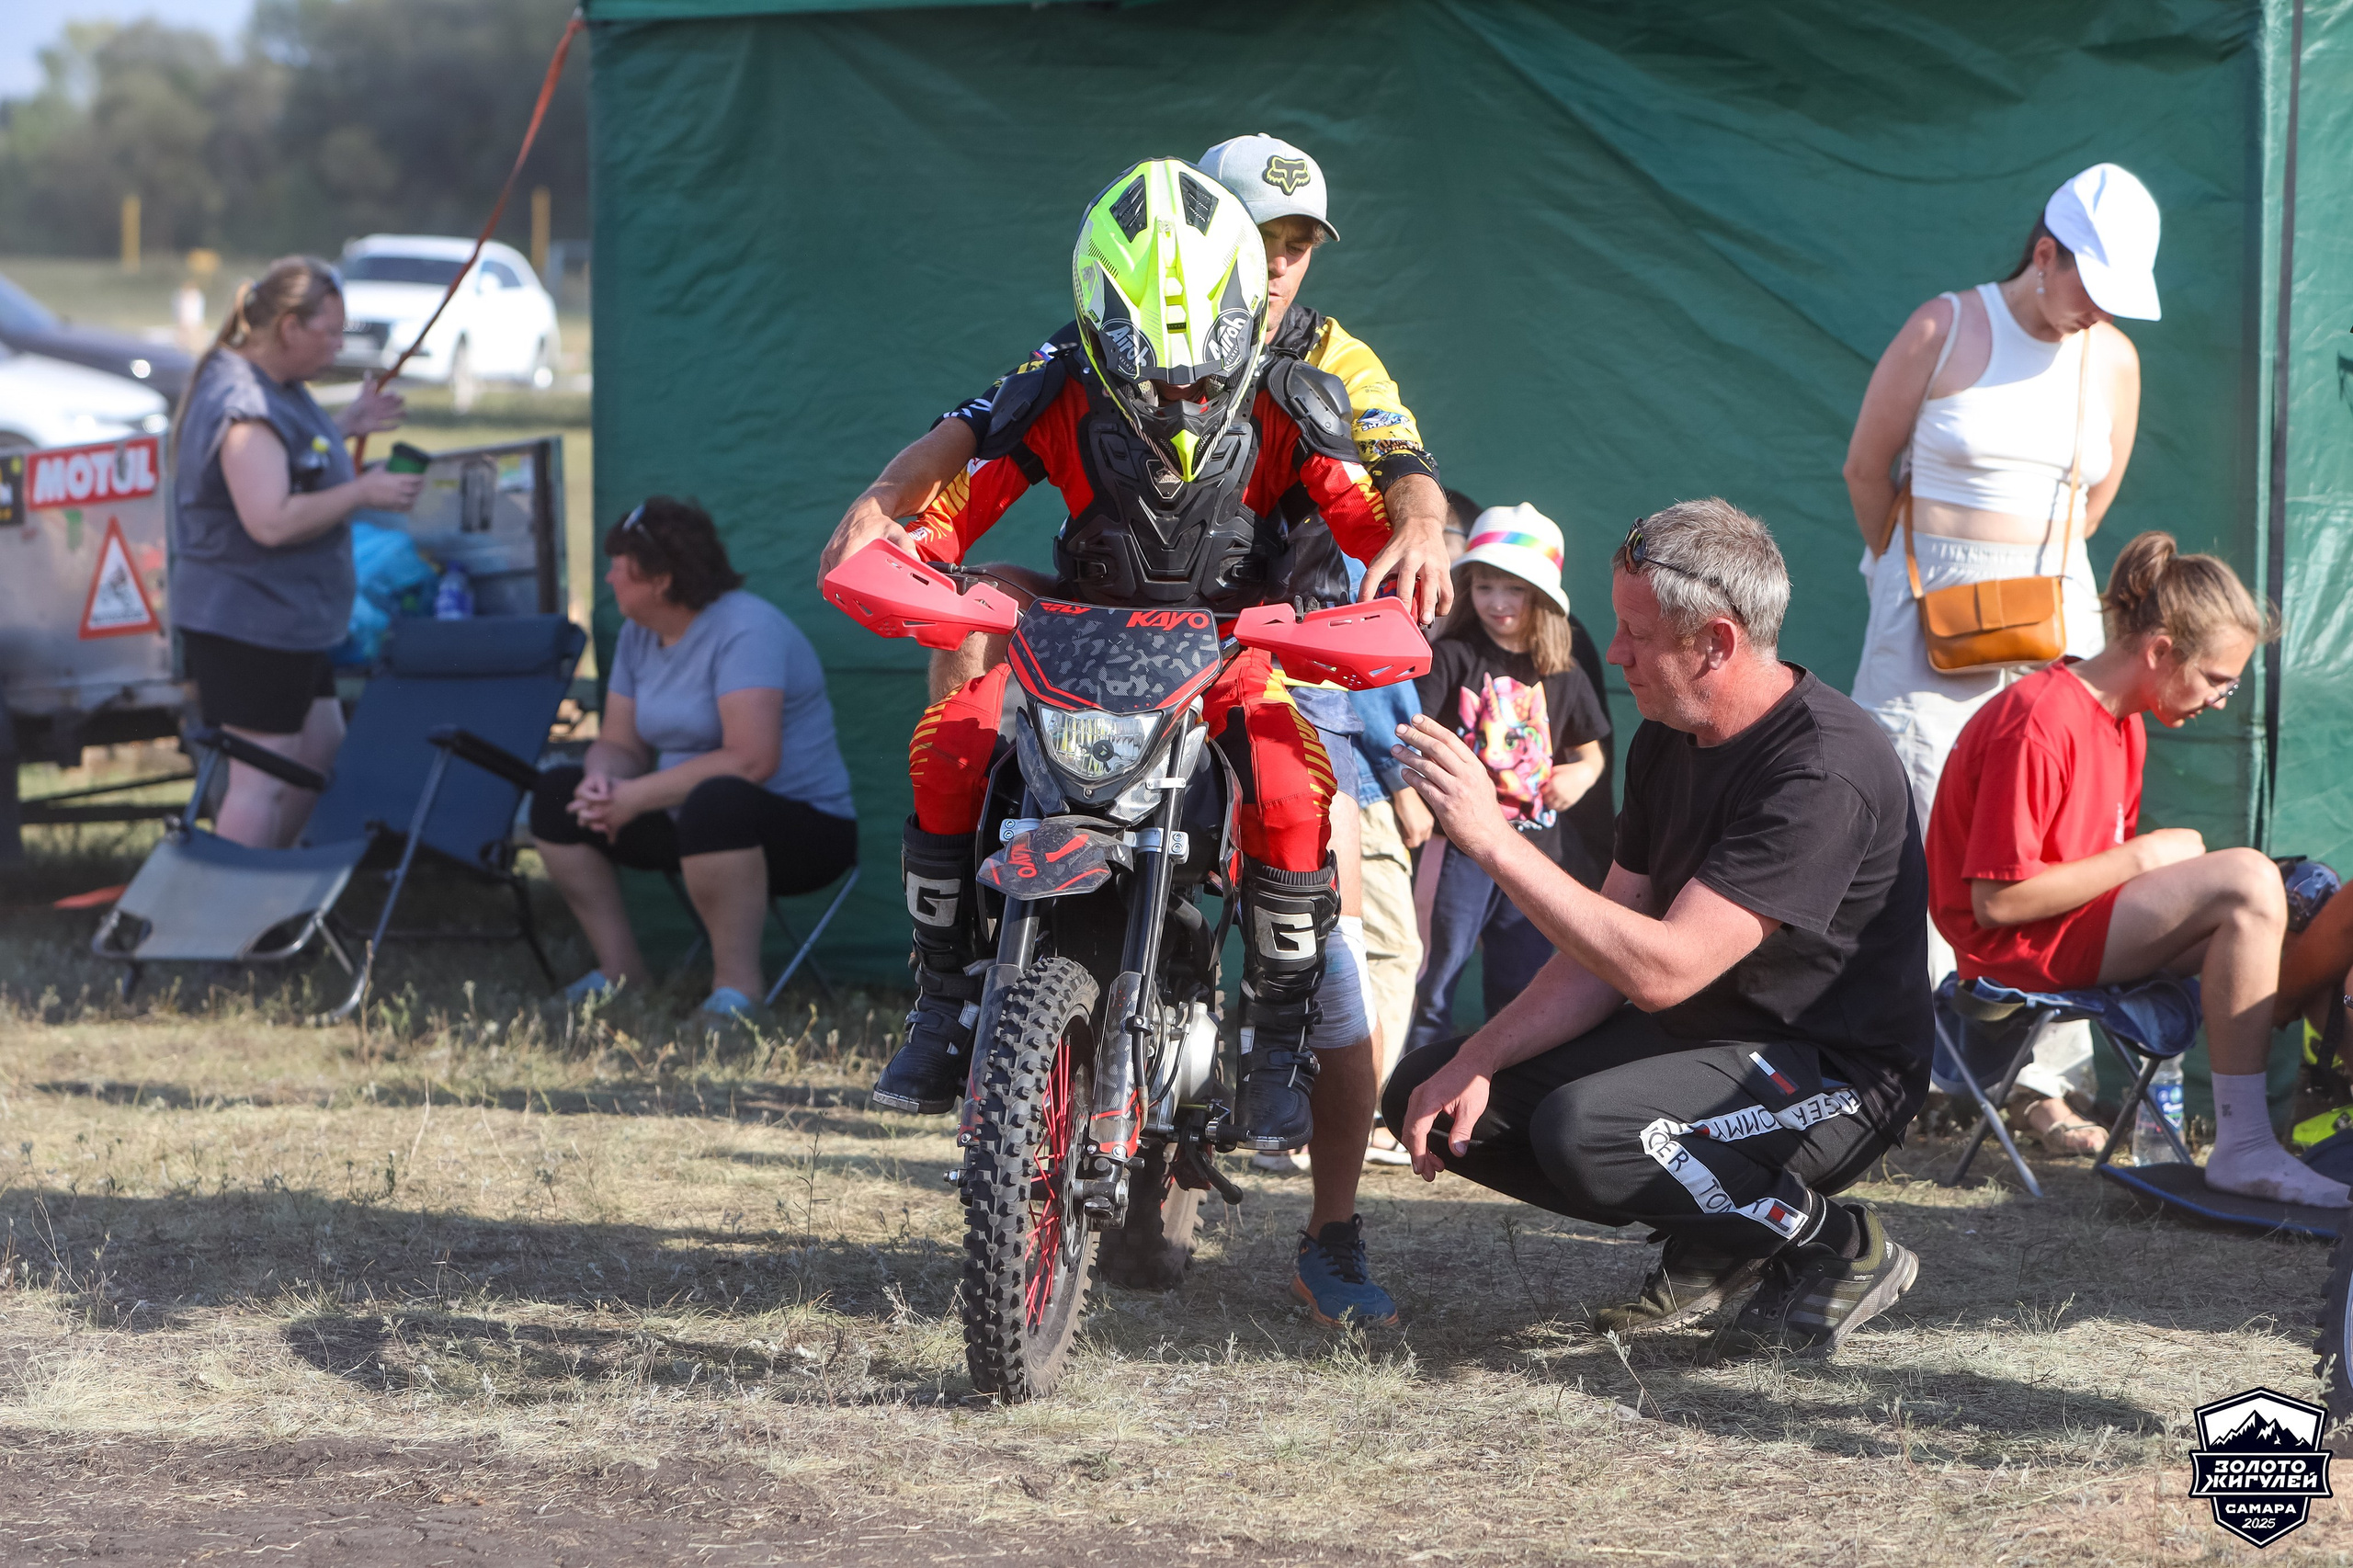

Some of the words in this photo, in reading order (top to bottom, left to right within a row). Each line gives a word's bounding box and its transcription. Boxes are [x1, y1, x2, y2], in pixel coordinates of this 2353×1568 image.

[1106, 325, 1150, 367] Airoh
[1208, 316, 1247, 361] Airoh
[33, 447, 155, 504] MOTUL
[1125, 609, 1210, 631] KAYO
[1713, 1108, 1777, 1140] OMMY
